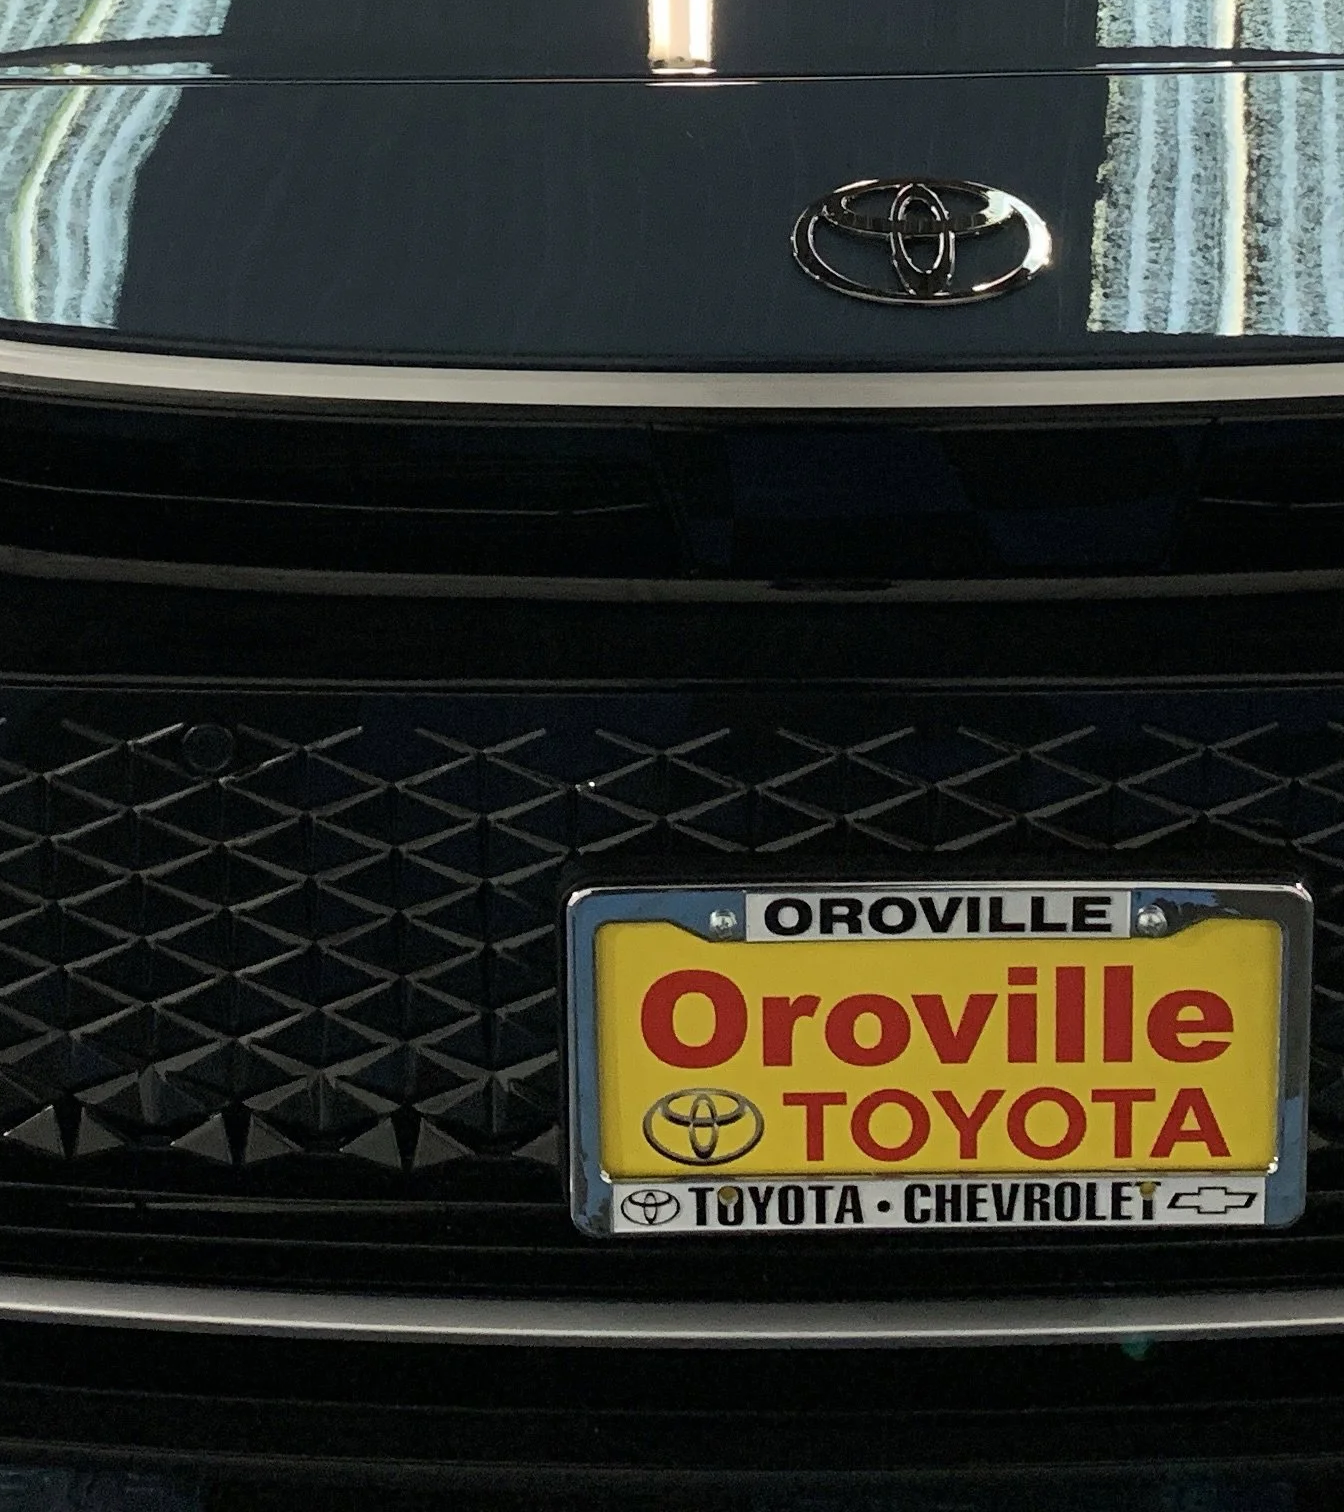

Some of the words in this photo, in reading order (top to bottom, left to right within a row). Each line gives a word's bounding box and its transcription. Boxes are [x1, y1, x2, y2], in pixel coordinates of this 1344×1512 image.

[763, 896, 1113, 936] OROVILLE
[640, 964, 1234, 1069] Oroville
[782, 1087, 1232, 1162] TOYOTA
[688, 1184, 864, 1227] TOYOTA
[903, 1181, 1162, 1224] CHEVROLET
